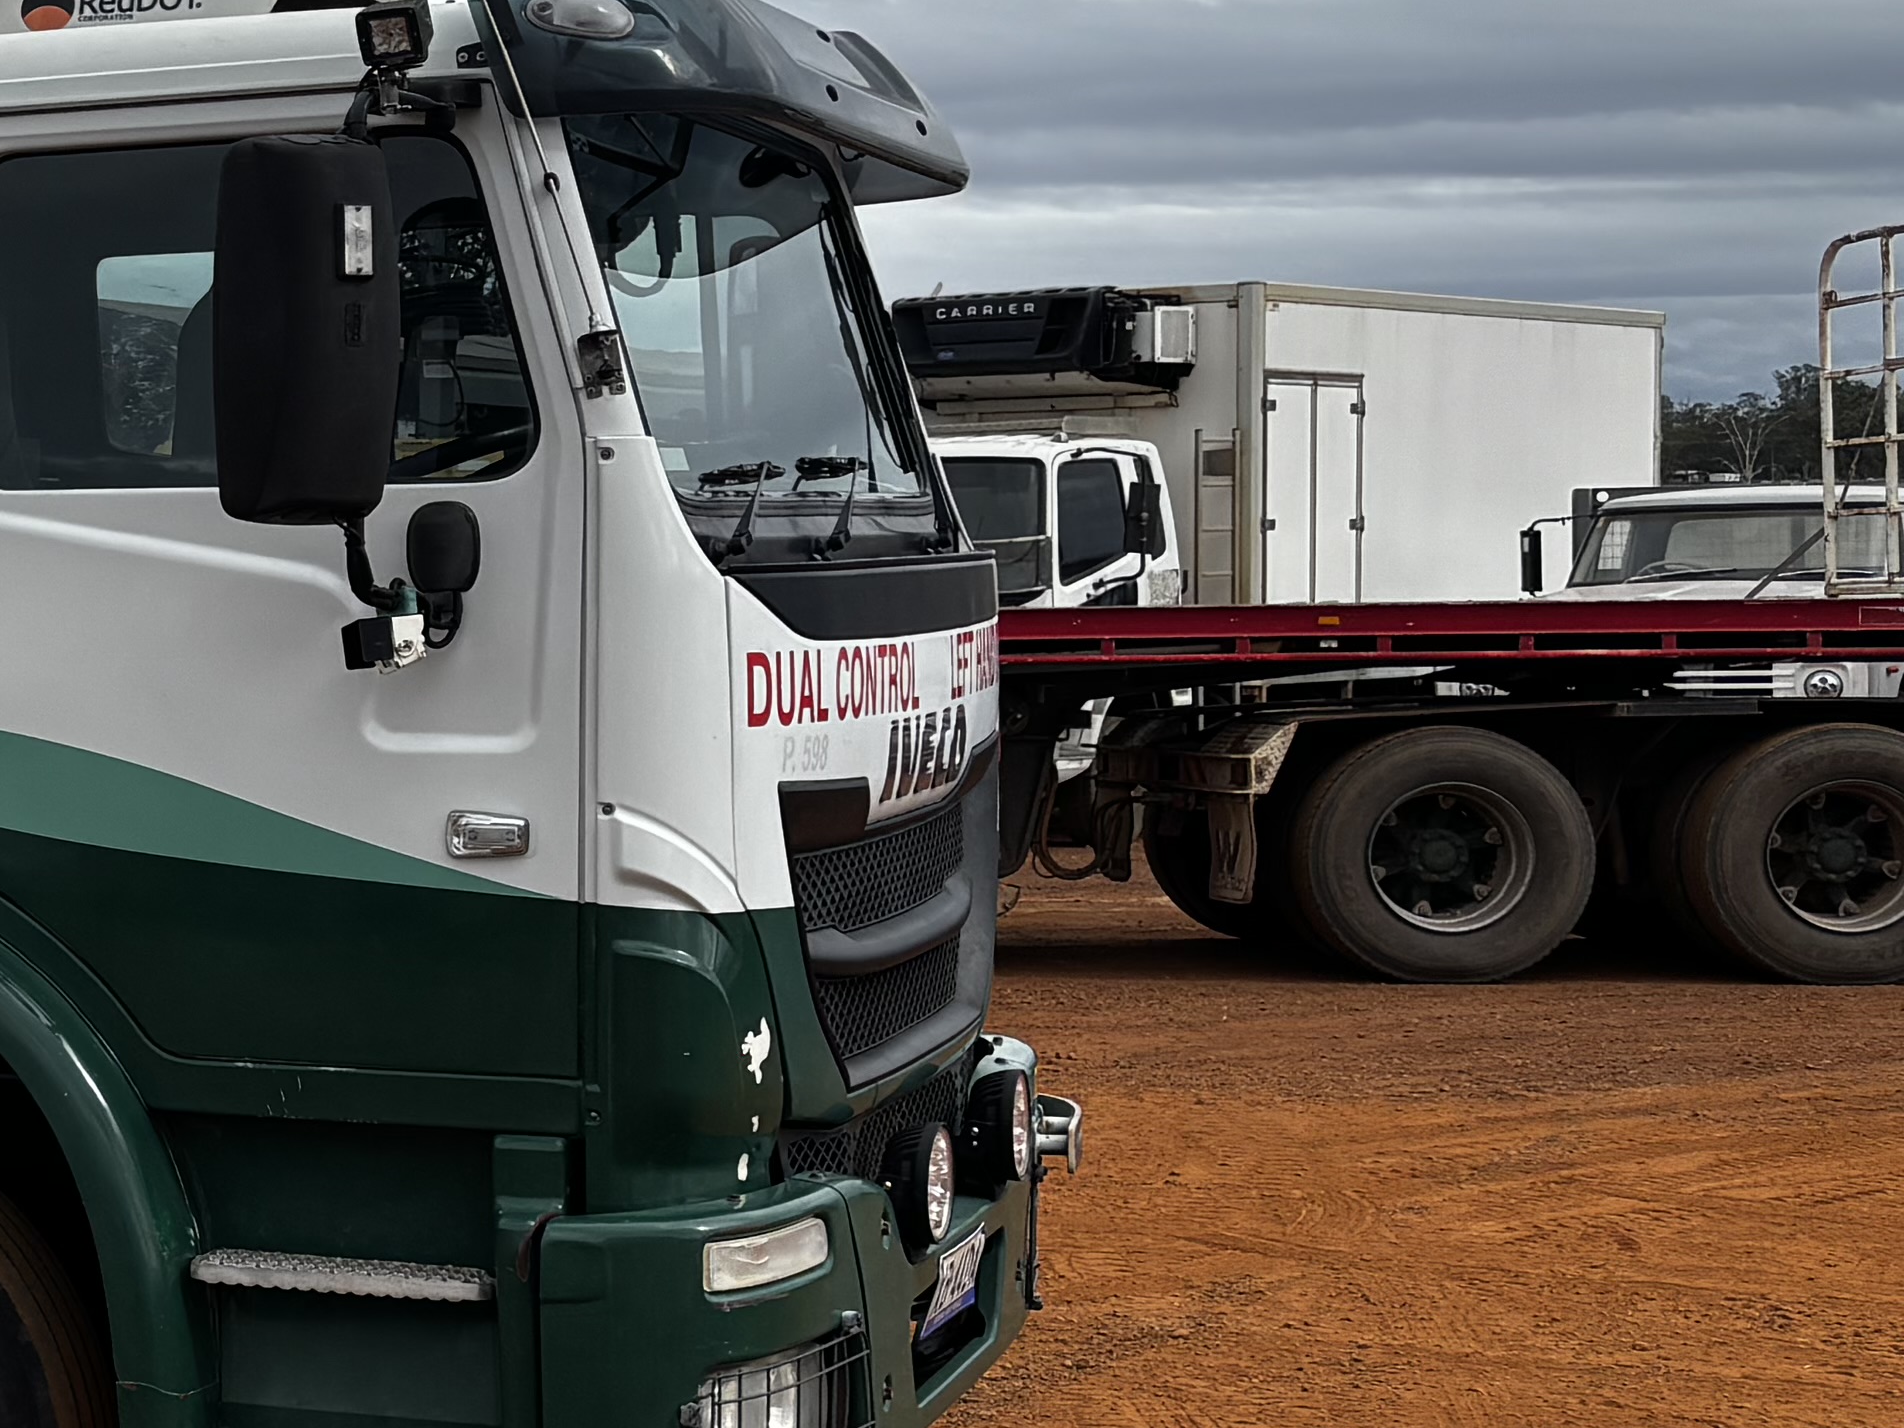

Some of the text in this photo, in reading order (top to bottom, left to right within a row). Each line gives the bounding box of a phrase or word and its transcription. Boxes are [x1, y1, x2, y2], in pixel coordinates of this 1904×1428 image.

[78, 14, 134, 23] CORPORATION
[936, 302, 1035, 320] CARRIER
[746, 648, 829, 728] DUAL
[835, 641, 920, 721] CONTROL
[950, 631, 974, 700] LEFT
[801, 733, 830, 772] 598
[879, 703, 967, 805] IVECO
